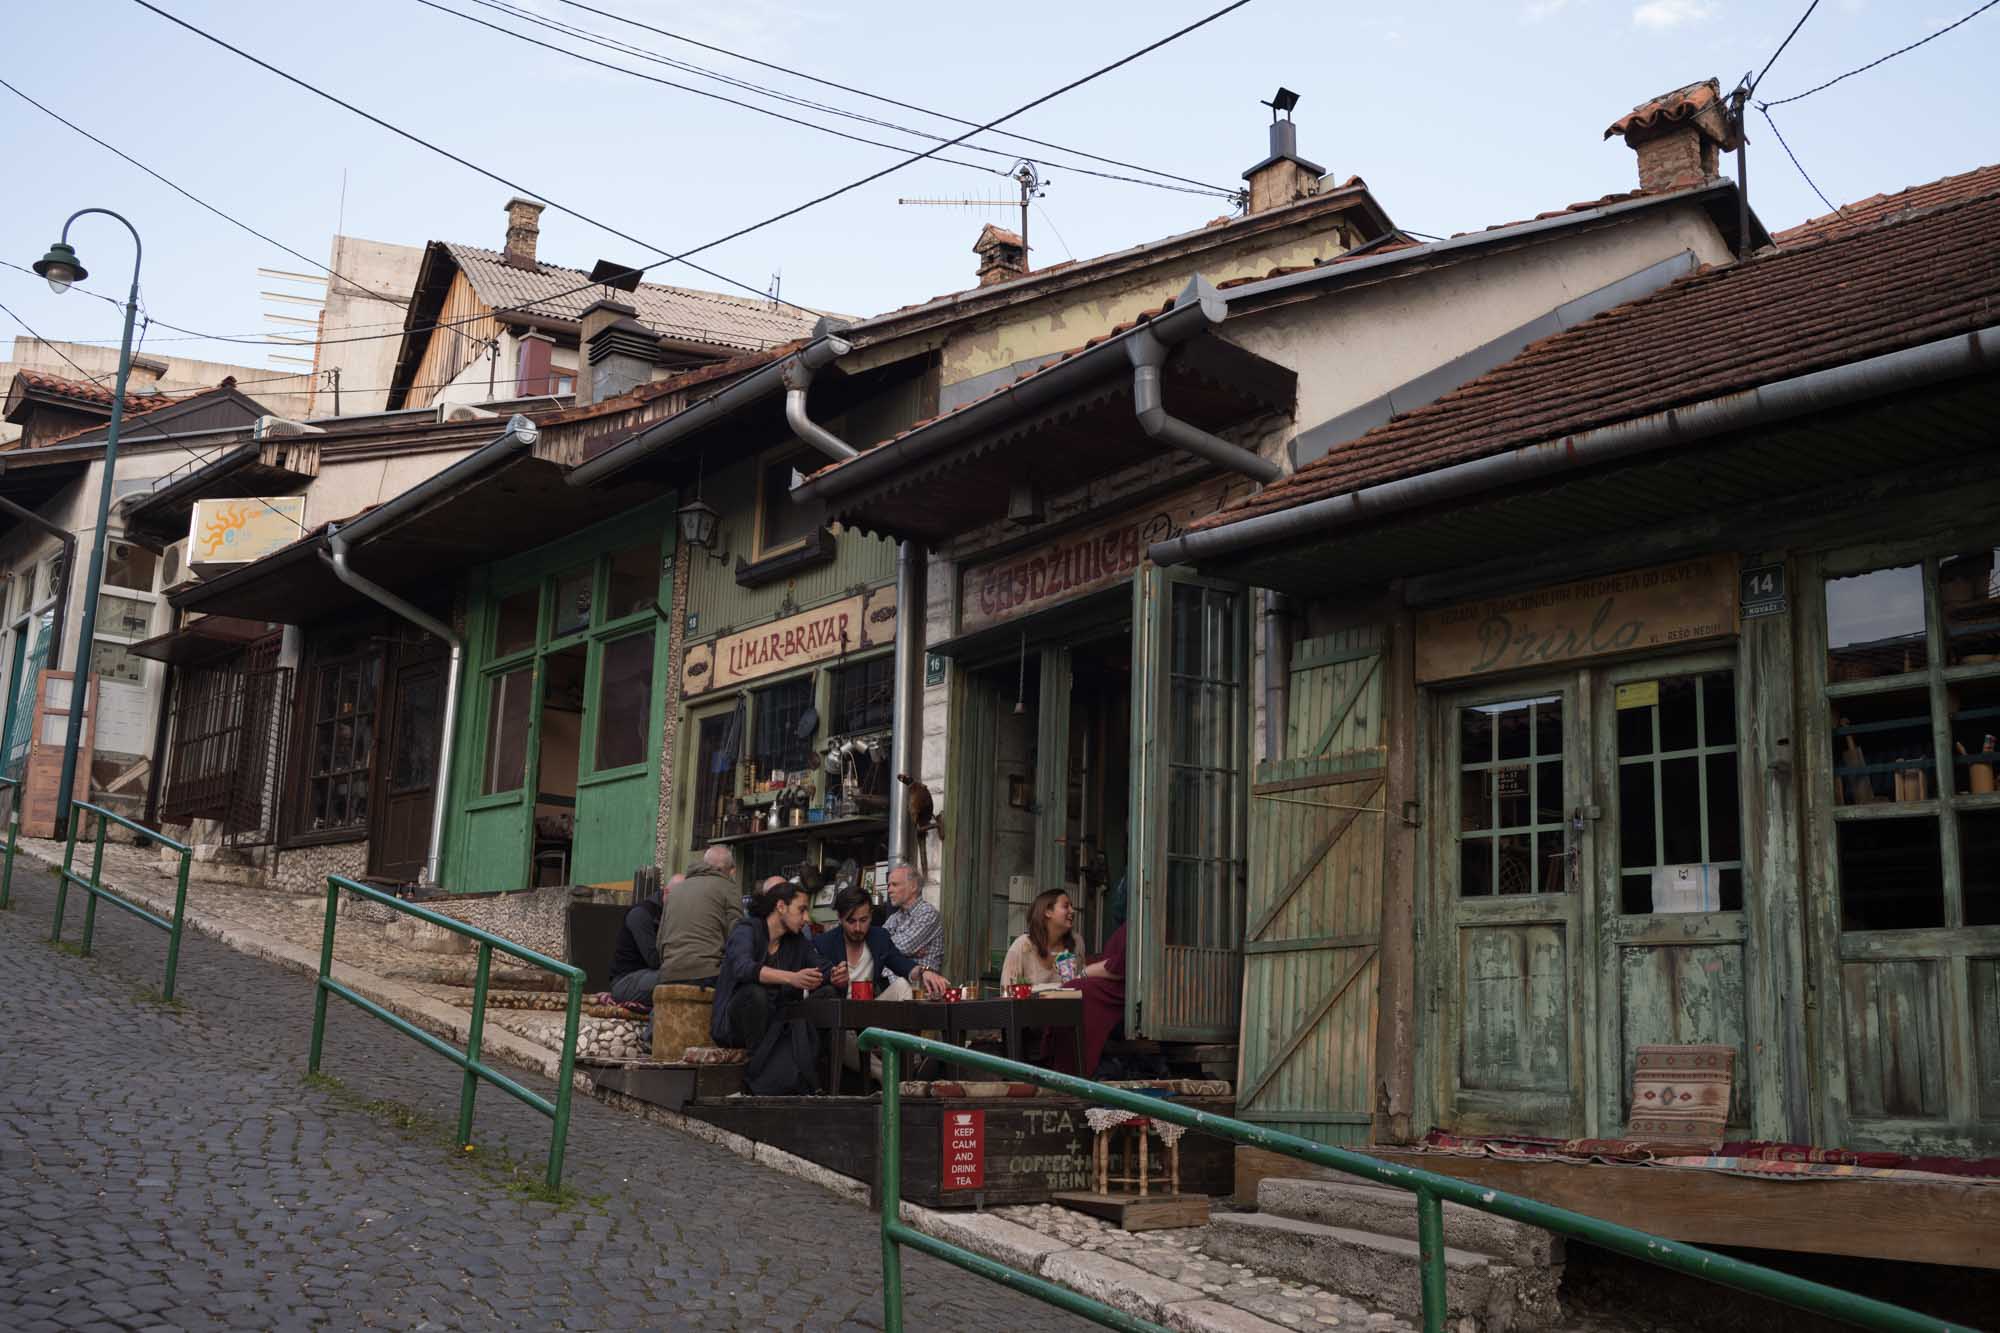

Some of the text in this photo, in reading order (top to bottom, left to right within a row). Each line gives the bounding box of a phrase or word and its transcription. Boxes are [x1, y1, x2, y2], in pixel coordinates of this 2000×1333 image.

[1750, 573, 1774, 595] 14
[930, 657, 941, 672] 16
[954, 1128, 975, 1137] KEEP
[952, 1140, 976, 1149] CALM
[954, 1152, 974, 1161] AND
[951, 1164, 976, 1173] DRINK
[955, 1176, 972, 1185] TEA
